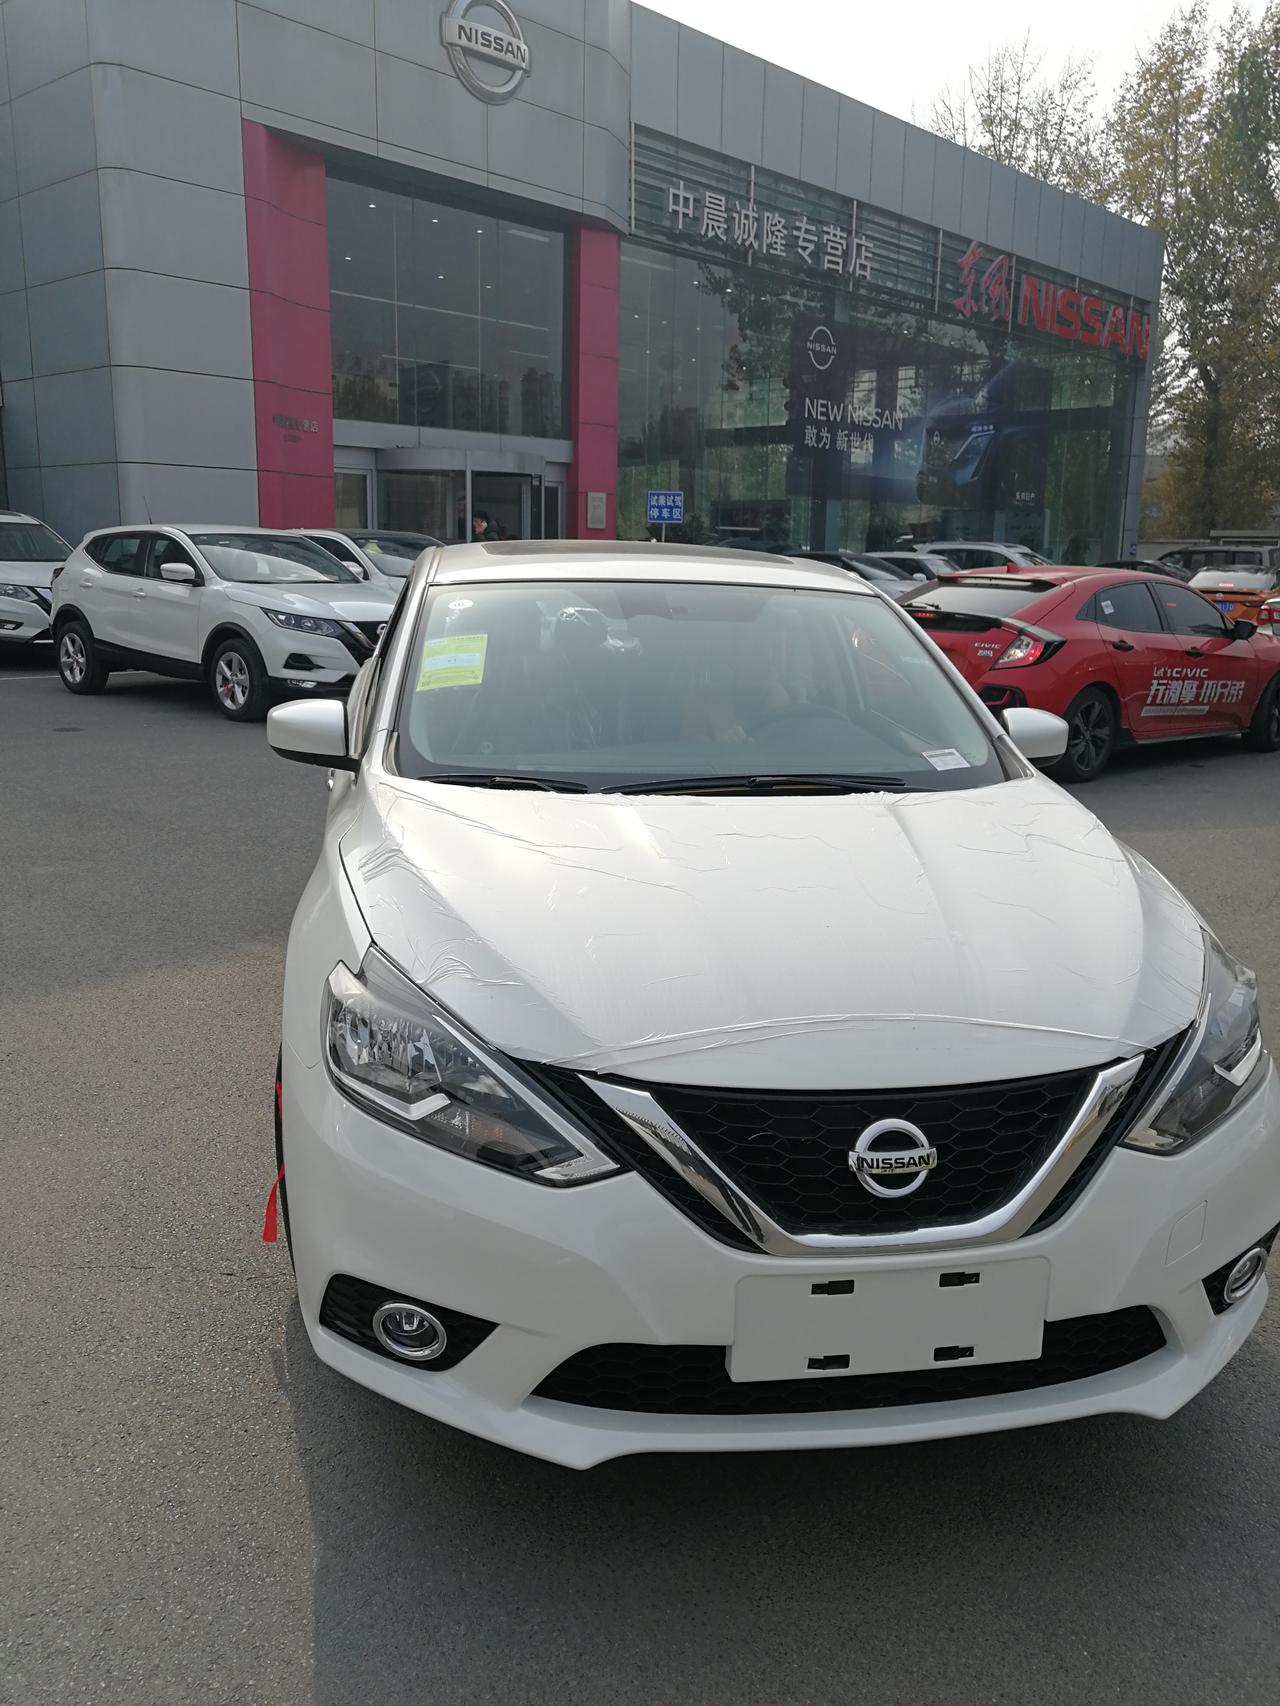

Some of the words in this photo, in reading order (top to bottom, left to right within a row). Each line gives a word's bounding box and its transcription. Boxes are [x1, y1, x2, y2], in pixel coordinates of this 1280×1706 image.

[457, 23, 526, 63] NISSAN
[668, 180, 874, 280] 中晨诚隆专营店
[1017, 273, 1151, 362] NISSAN
[806, 341, 838, 355] NISSAN
[804, 397, 844, 423] NEW
[847, 404, 903, 431] NISSAN
[804, 424, 831, 449] 敢为
[650, 507, 681, 519] 停车区
[974, 641, 1001, 650] CIVIC
[1172, 667, 1209, 678] CIVIC
[860, 1154, 931, 1170] NISSAN
